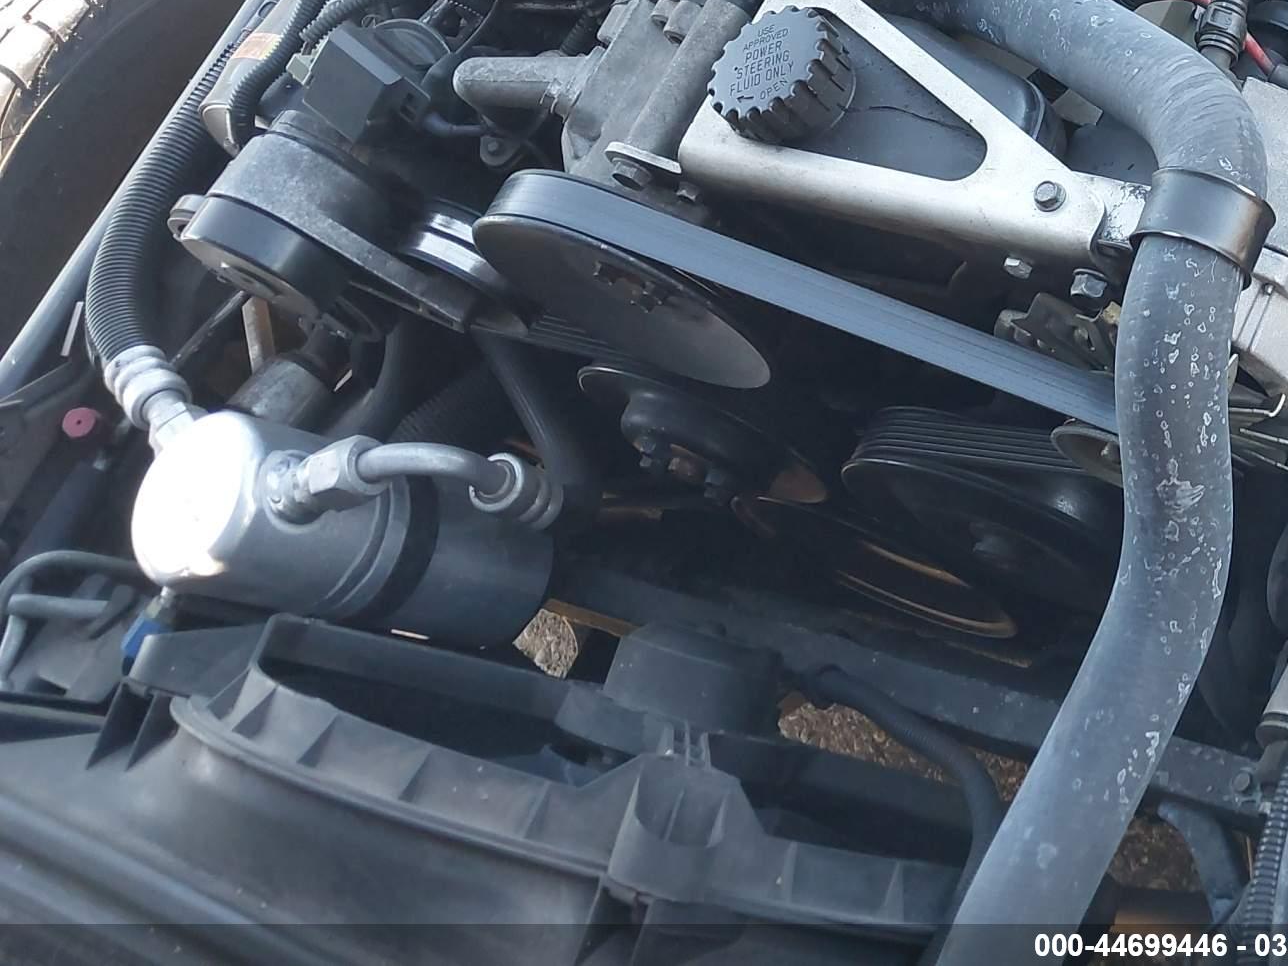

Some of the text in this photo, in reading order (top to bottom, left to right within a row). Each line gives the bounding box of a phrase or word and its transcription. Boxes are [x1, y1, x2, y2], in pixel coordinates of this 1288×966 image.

[743, 27, 789, 52] APPROVED
[757, 24, 776, 37] USE
[745, 41, 783, 62] POWER
[736, 50, 790, 80] STEERING
[729, 62, 794, 96] FLUID ONLY
[760, 78, 789, 100] OPEN
